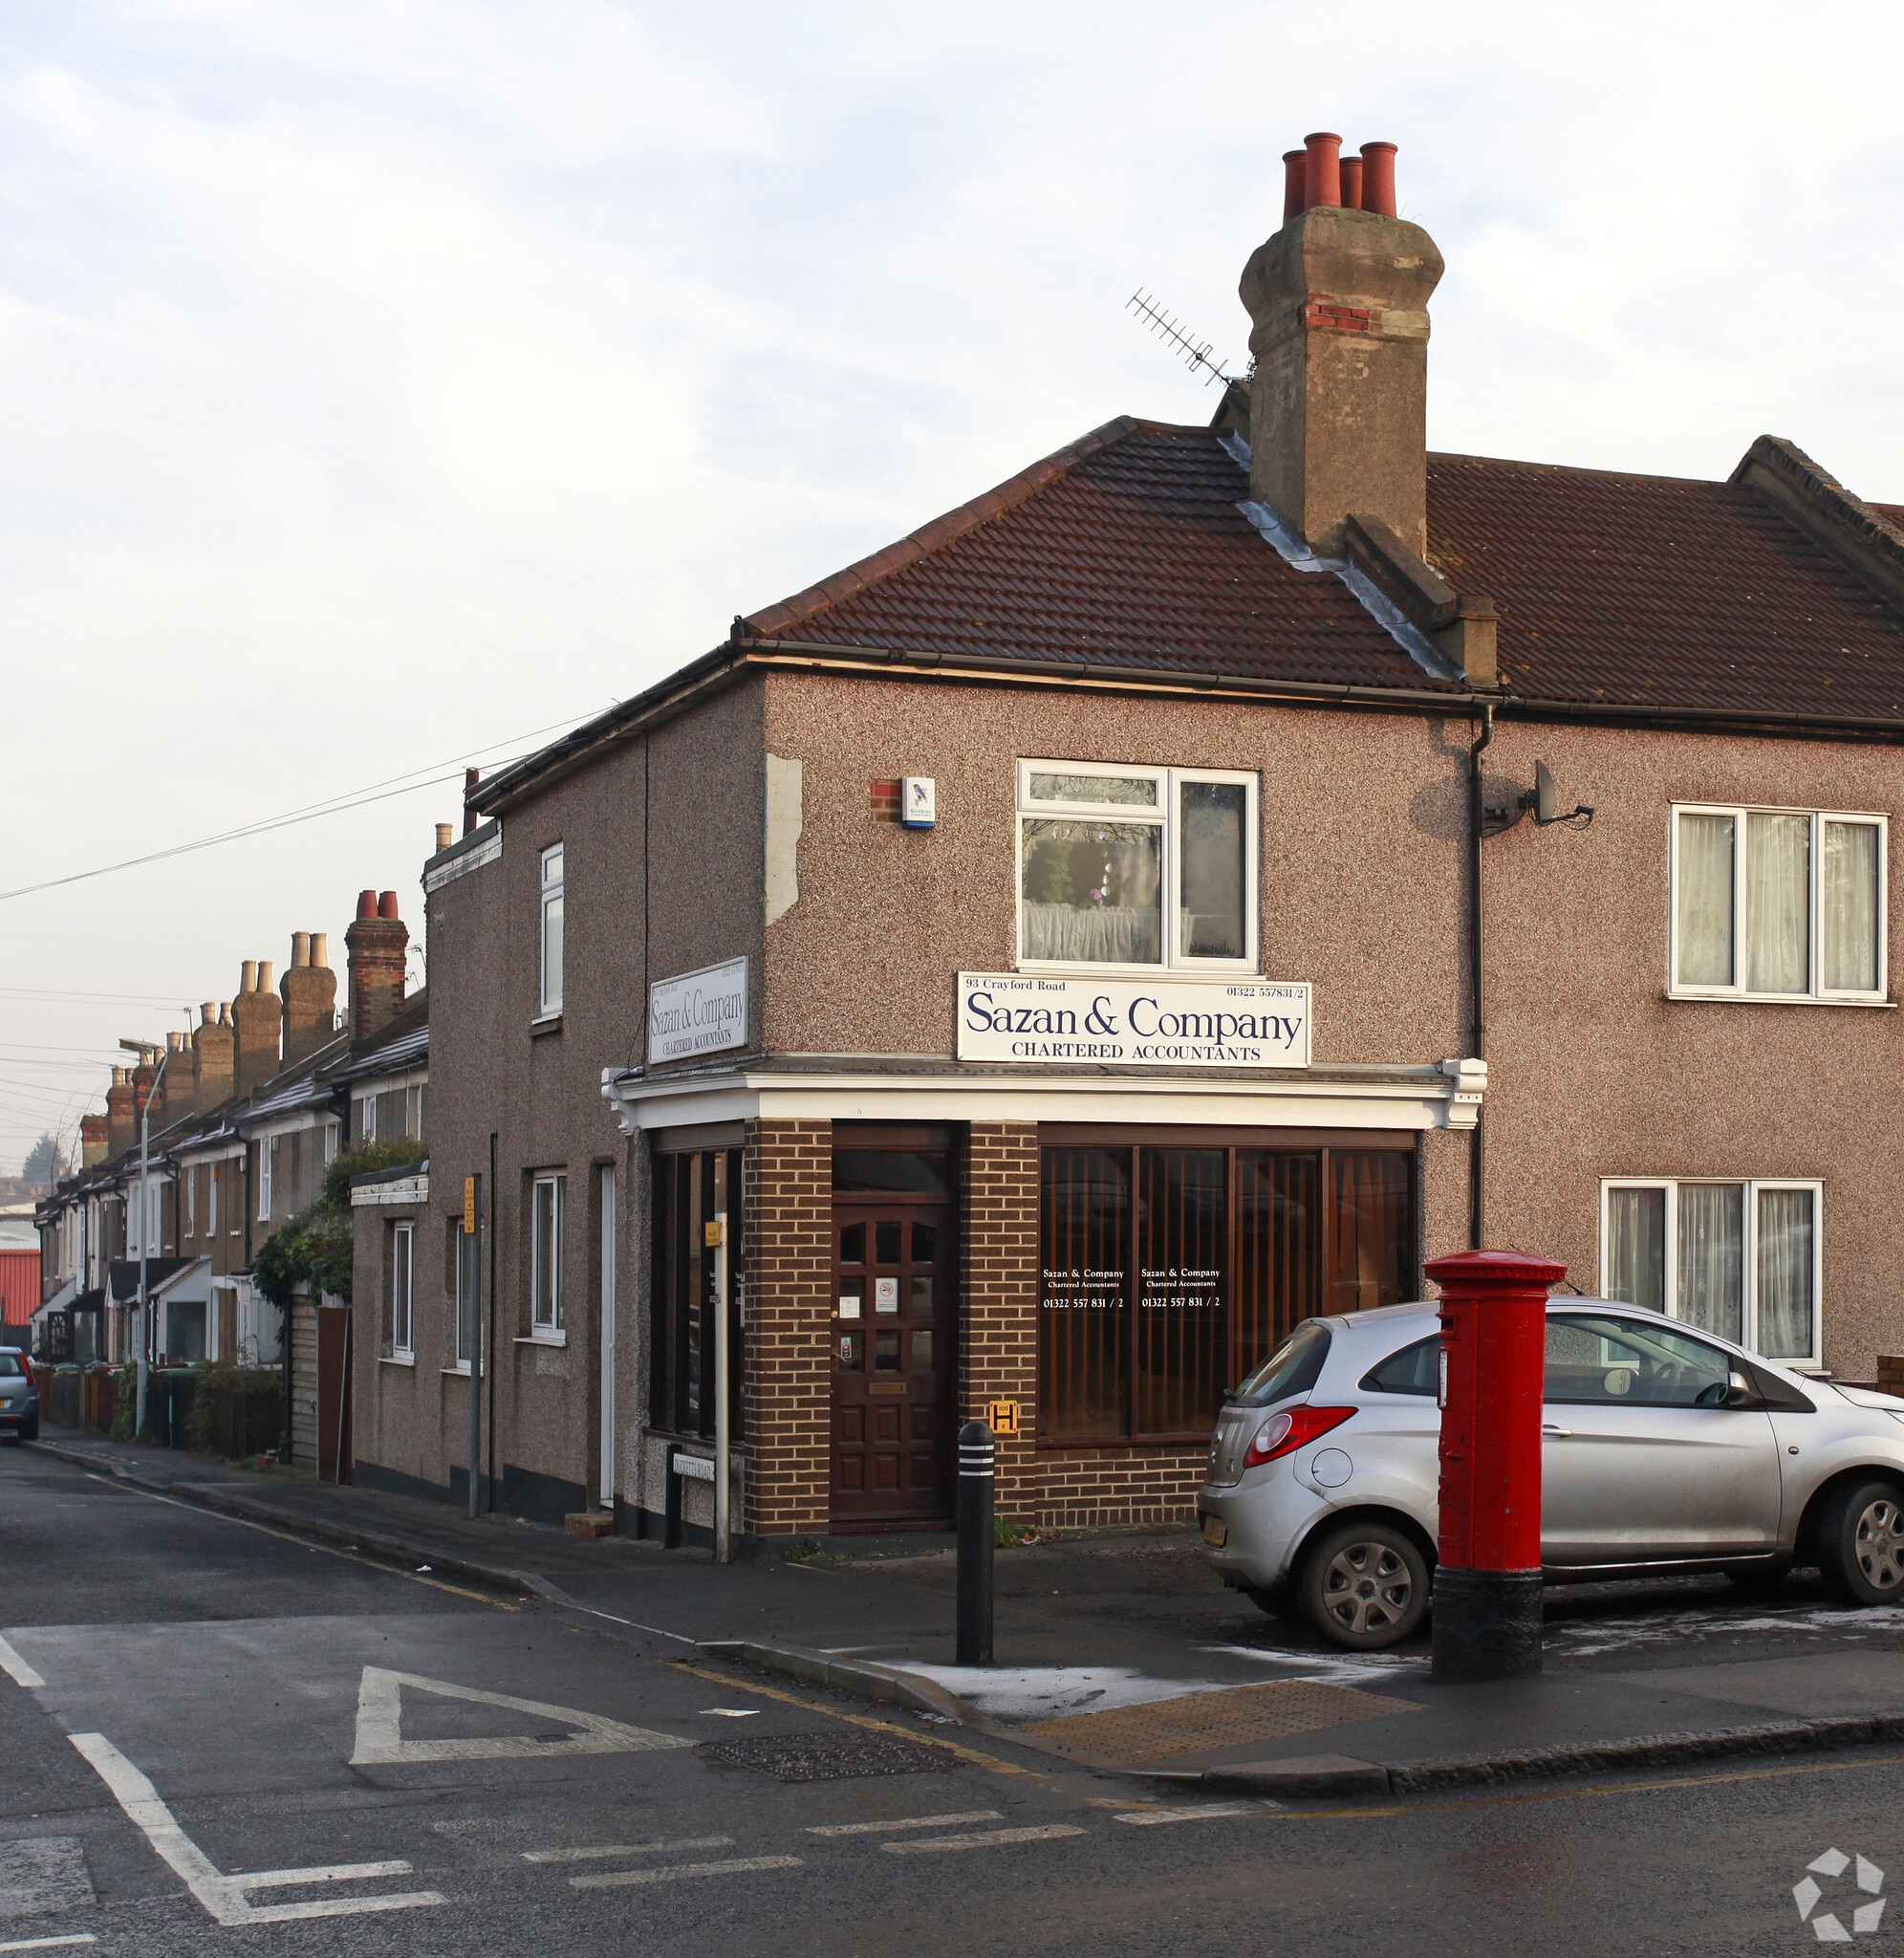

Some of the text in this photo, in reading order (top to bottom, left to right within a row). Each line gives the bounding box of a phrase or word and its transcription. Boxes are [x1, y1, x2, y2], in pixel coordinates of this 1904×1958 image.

[965, 978, 1066, 991] 93 Crayford Road
[1226, 987, 1304, 999] 01322 557831/2
[653, 989, 745, 1036] Sazan & Company
[966, 991, 1303, 1050] Sazan & Company
[662, 1029, 732, 1055] CHARTERED ACCOUNTANTS
[1011, 1041, 1261, 1061] CHARTERED ACCOUNTANTS
[1043, 1269, 1124, 1279] Sazan & Company
[1141, 1268, 1221, 1278] Sazan & Company
[1043, 1298, 1070, 1308] 01322
[1073, 1298, 1089, 1308] 557
[1092, 1298, 1106, 1308] 831
[1119, 1298, 1124, 1308] 2
[1141, 1297, 1167, 1307] 01322
[1171, 1297, 1185, 1307] 557
[1188, 1297, 1202, 1307] 831
[1215, 1297, 1220, 1307] 2
[994, 1404, 1013, 1430] H
